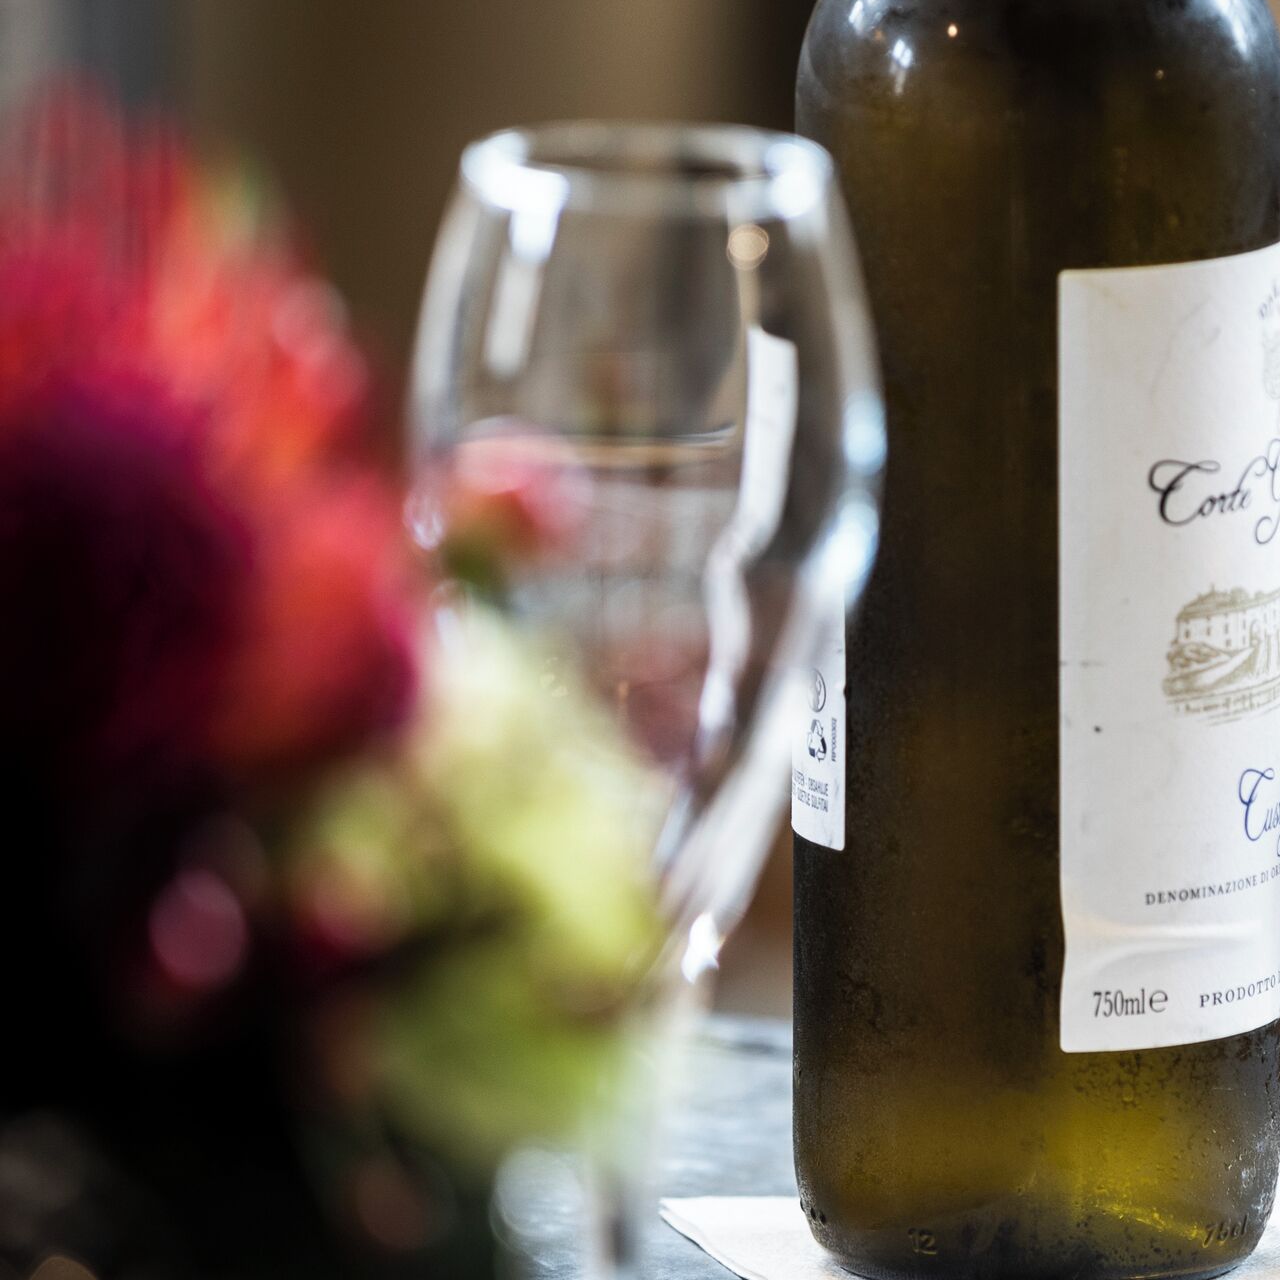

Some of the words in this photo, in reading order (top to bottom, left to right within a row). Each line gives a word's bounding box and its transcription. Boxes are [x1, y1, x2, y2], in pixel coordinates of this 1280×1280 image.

[1148, 458, 1252, 528] Corte
[1145, 874, 1258, 906] DENOMINAZIONE
[1260, 871, 1270, 885] DI
[1199, 974, 1277, 1009] PRODOTTO
